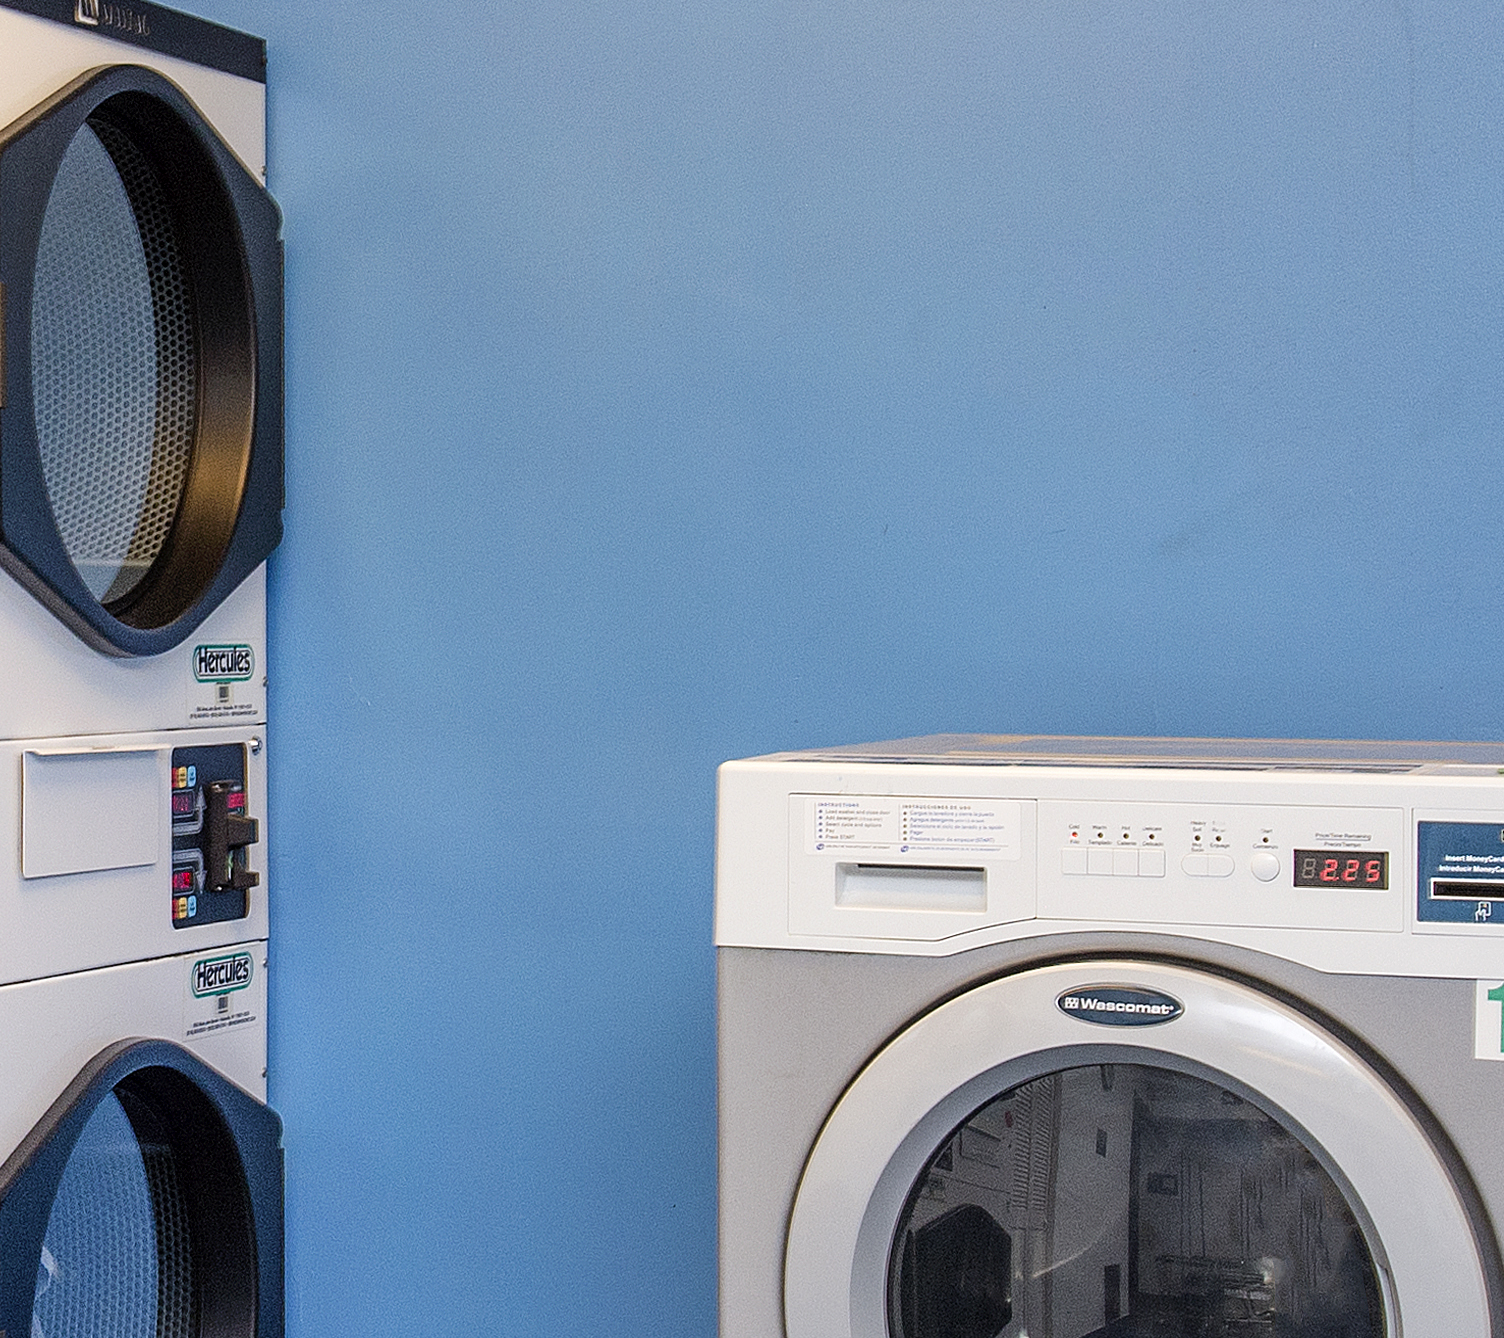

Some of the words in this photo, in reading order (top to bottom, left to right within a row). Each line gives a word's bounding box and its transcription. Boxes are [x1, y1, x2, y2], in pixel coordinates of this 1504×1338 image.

[198, 646, 251, 673] Hercules
[1438, 864, 1472, 873] Introducir
[1445, 854, 1465, 863] Insert
[1466, 855, 1503, 865] MoneyCard
[197, 955, 249, 989] Hercules
